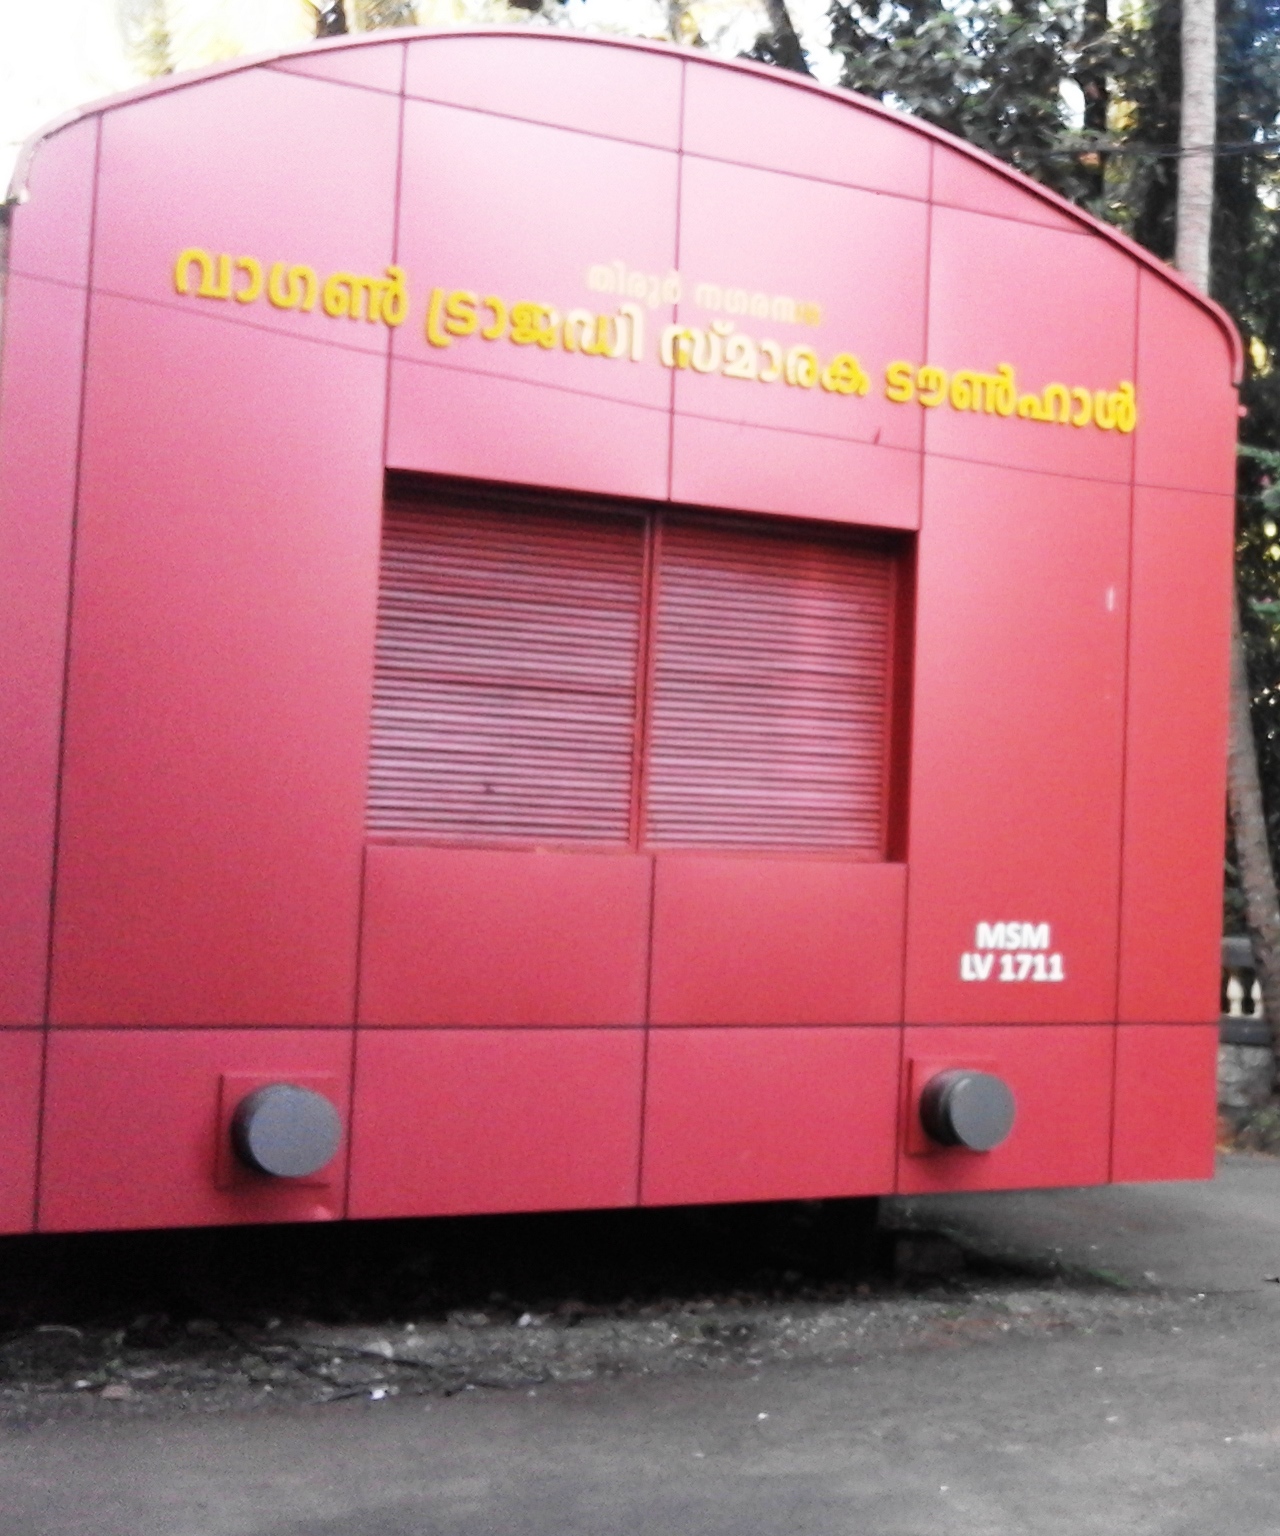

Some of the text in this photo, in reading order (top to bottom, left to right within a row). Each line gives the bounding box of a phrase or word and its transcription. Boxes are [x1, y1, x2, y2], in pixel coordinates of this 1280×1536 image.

[174, 248, 407, 326] വാഗൺ
[660, 320, 870, 397] സ്മാരക
[977, 921, 1050, 950] MSM
[961, 952, 1064, 982] LV 1711
